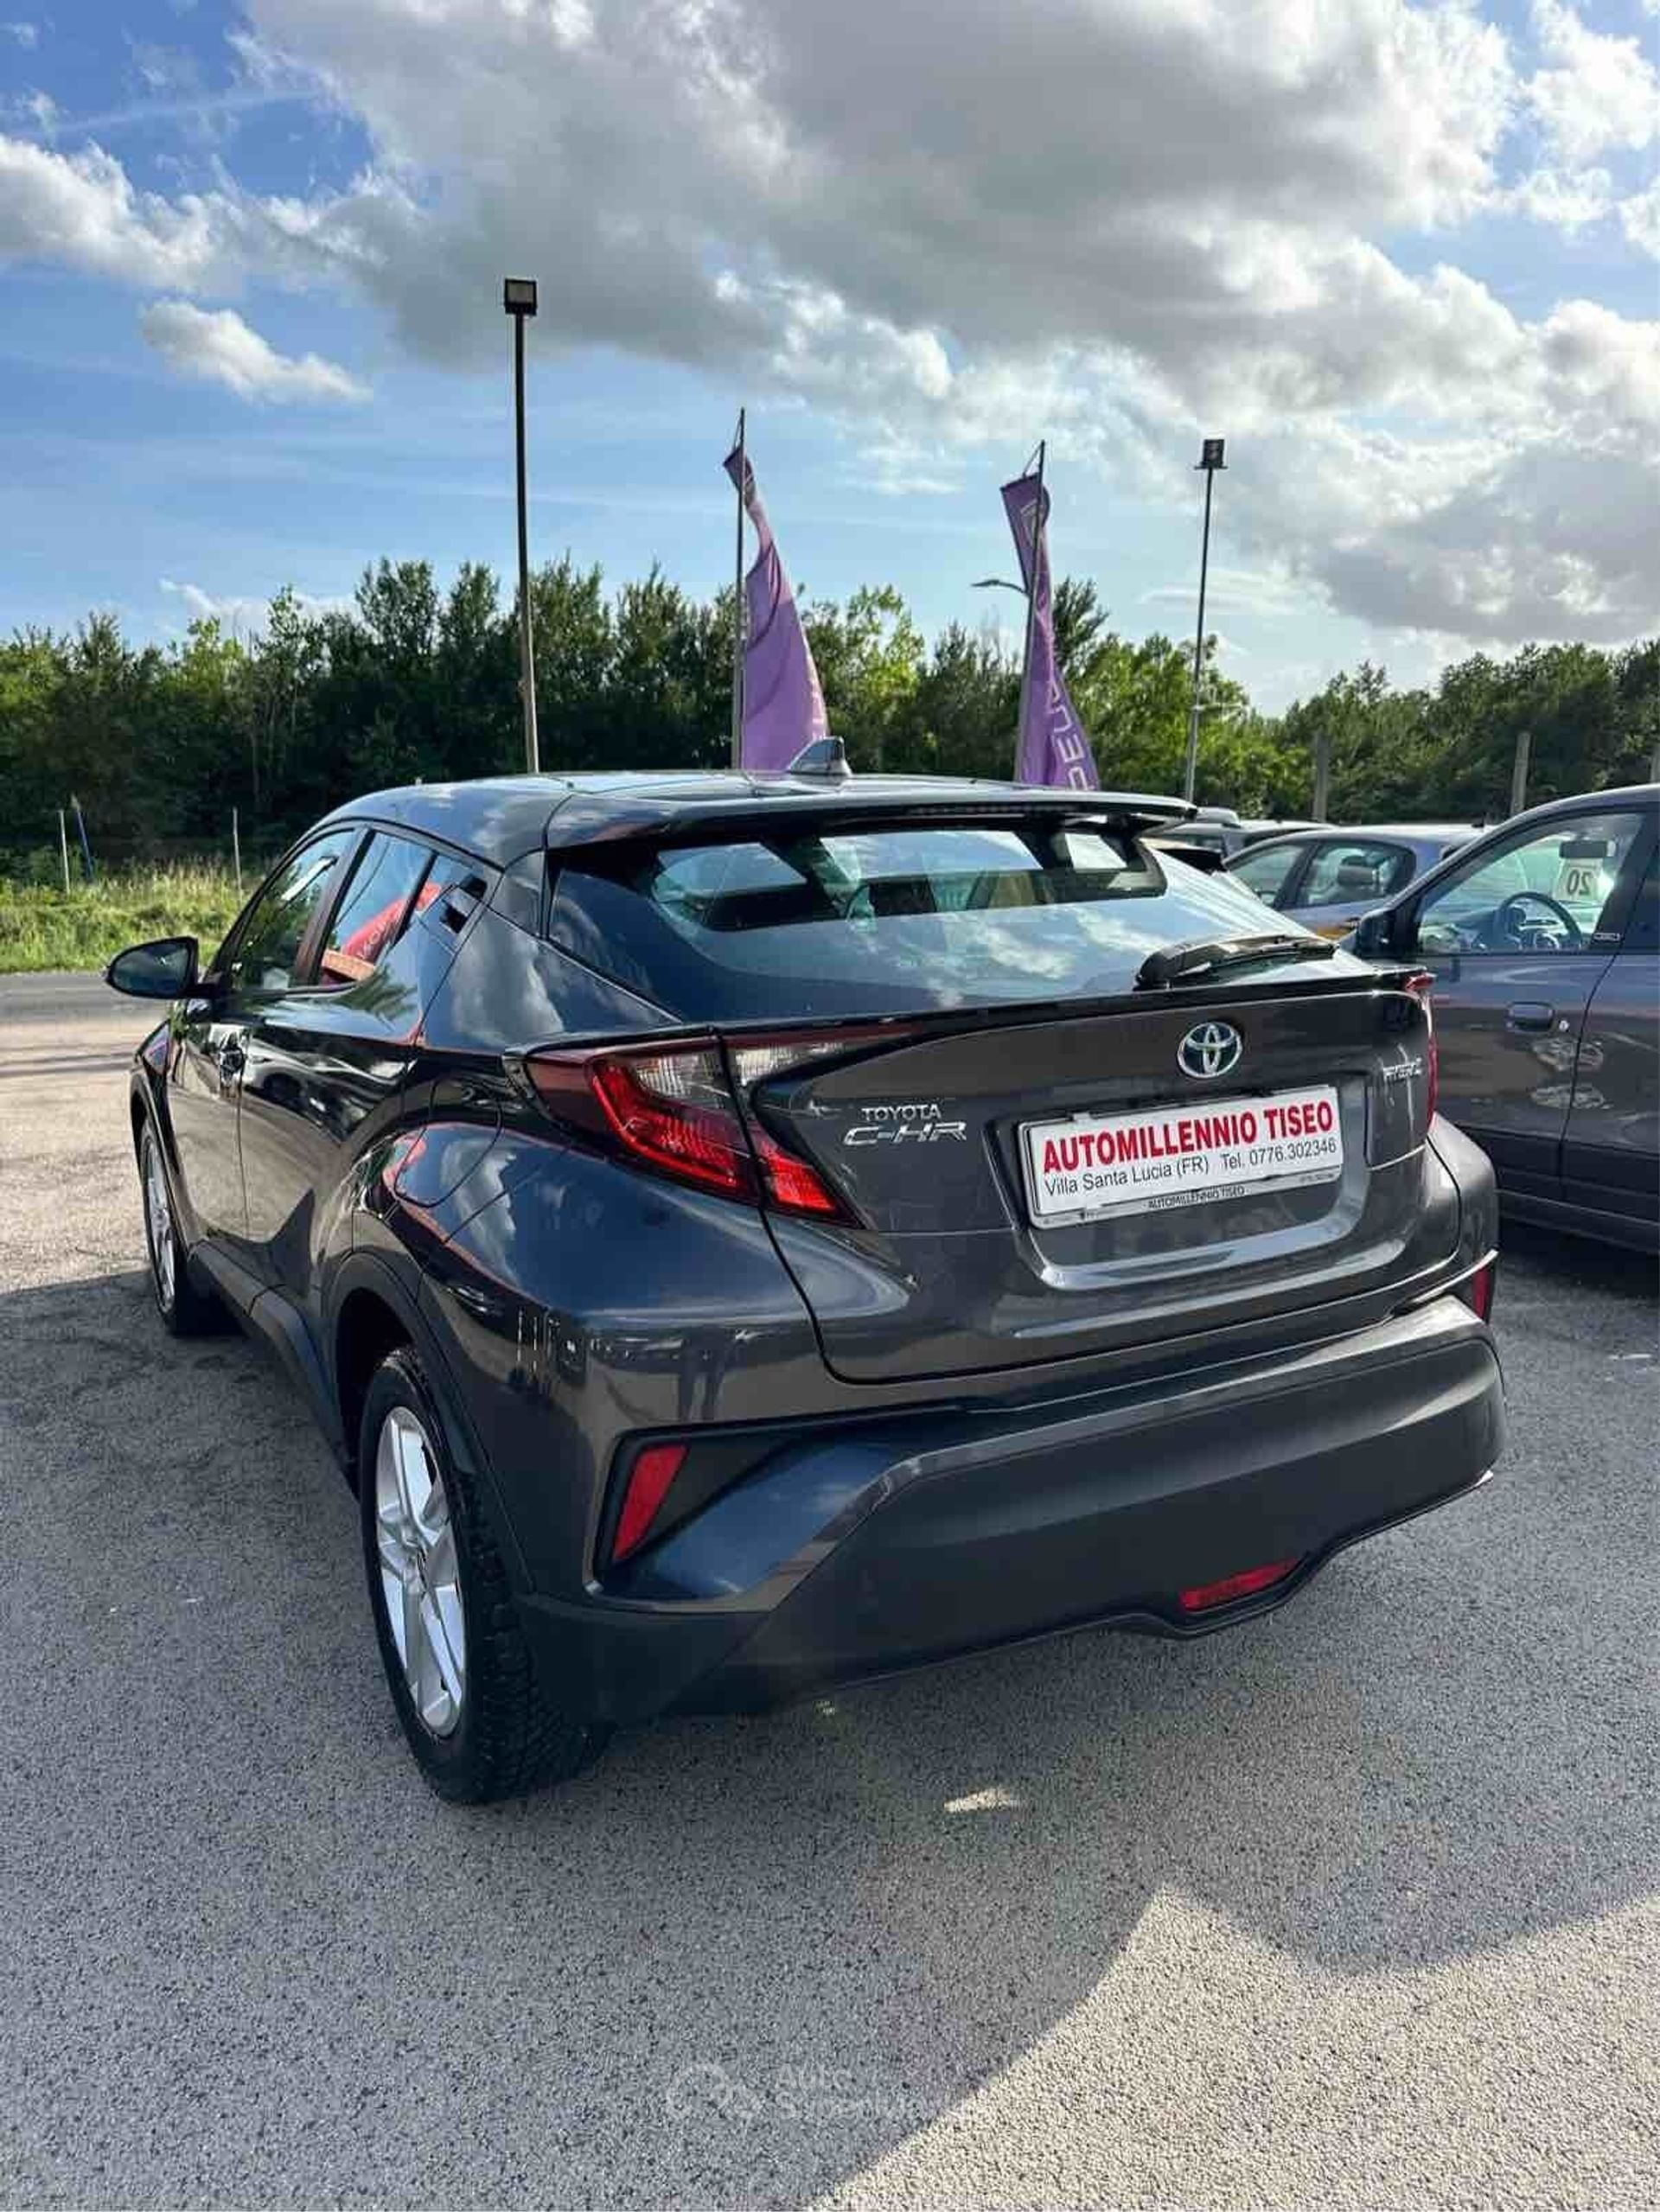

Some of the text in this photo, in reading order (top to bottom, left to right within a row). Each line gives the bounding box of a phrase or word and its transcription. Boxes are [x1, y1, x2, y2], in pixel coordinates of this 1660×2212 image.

[862, 1103, 942, 1121] TOYOTA
[843, 1122, 967, 1145] C-HR
[1044, 1100, 1333, 1174] AUTOMILLENNIO TISEO
[1044, 1138, 1338, 1196] Villa Santa Lucia (FR) Tel. 0776.302346
